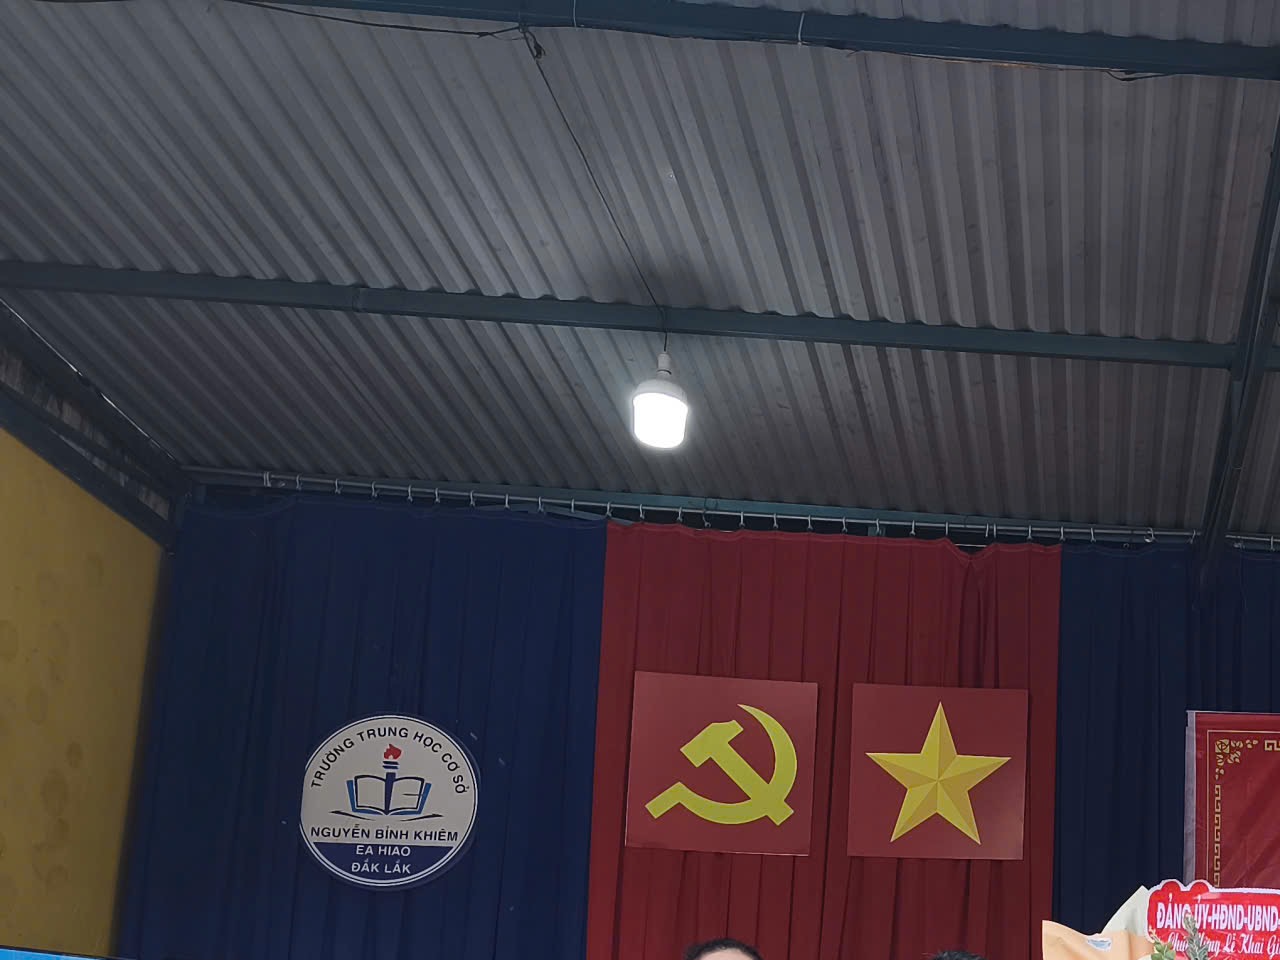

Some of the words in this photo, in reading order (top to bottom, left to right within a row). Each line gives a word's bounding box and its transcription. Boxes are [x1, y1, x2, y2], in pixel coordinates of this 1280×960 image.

[311, 737, 355, 788] TRƯỜNG
[357, 727, 409, 742] TRUNG
[413, 731, 442, 753] HỌC
[441, 752, 461, 772] CƠ
[453, 774, 470, 794] SỞ
[310, 823, 370, 839] NGUYỄN
[413, 828, 458, 842] KHIÊM
[356, 845, 374, 856] EA
[378, 846, 411, 857] HIAO
[351, 858, 380, 873] ĐẮK
[384, 860, 411, 874] LẮK
[1238, 933, 1264, 954] Khai
